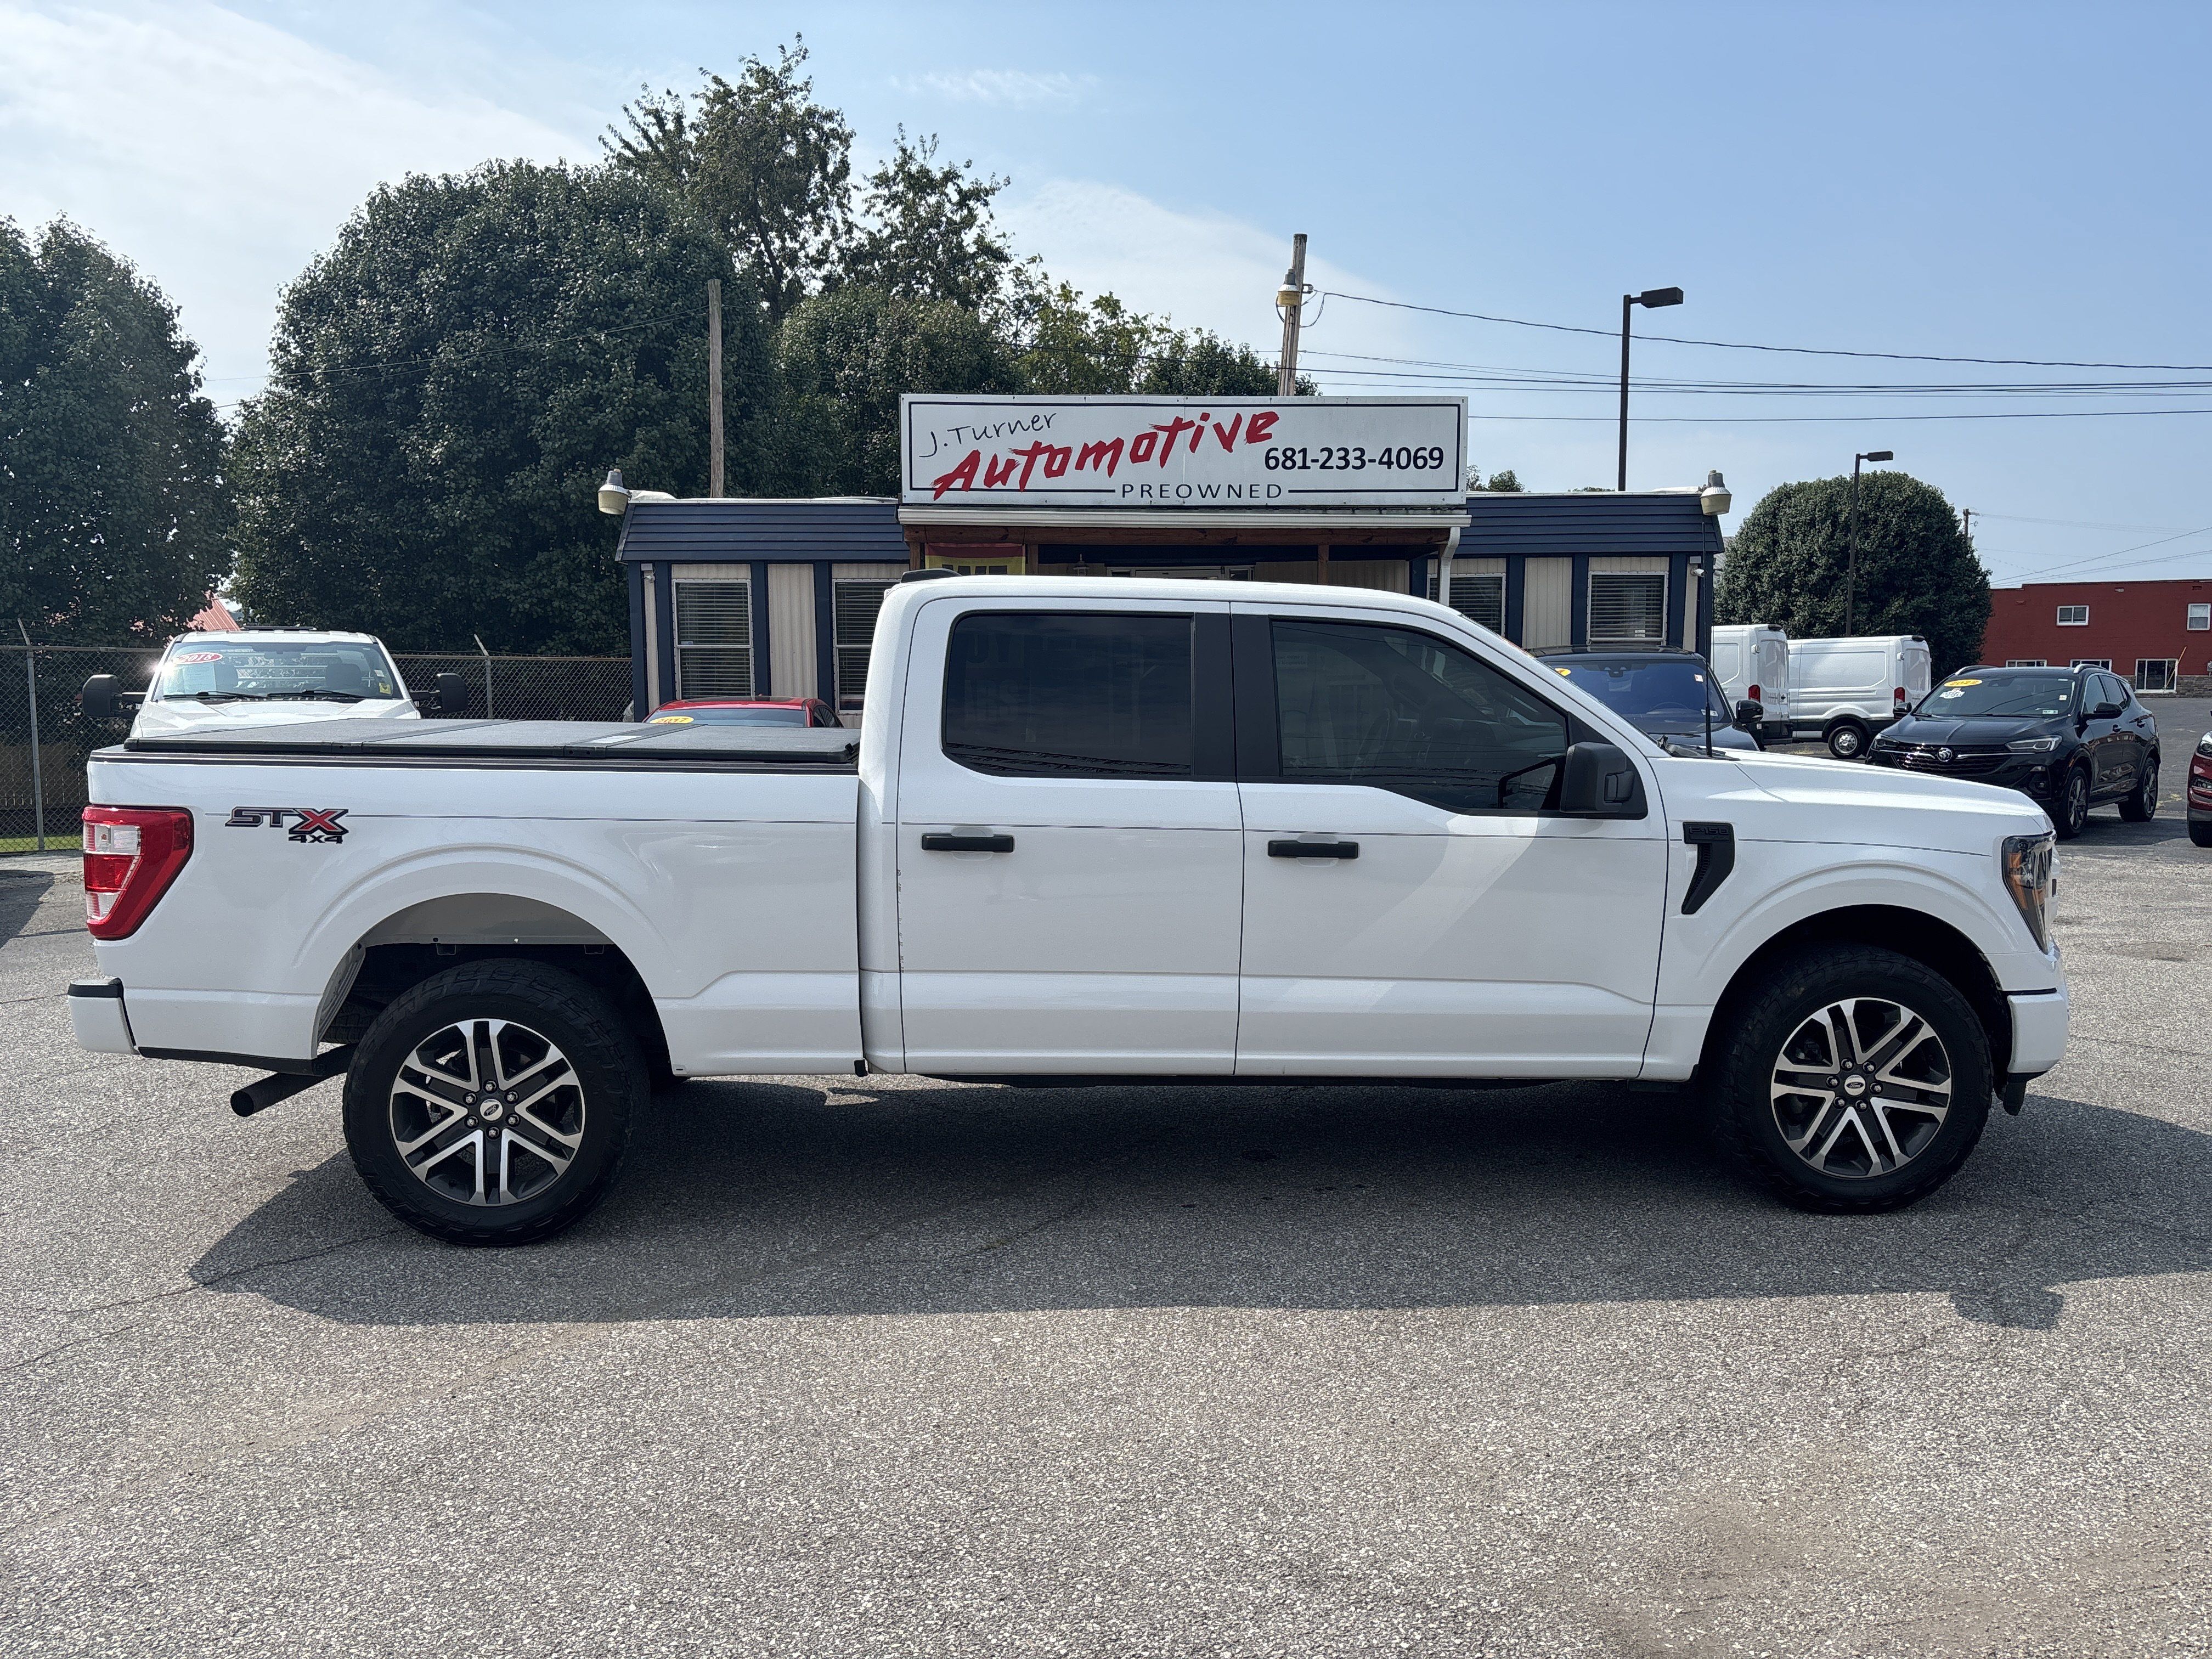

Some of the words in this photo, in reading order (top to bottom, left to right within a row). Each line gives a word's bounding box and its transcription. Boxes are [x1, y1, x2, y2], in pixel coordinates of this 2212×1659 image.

[930, 411, 1280, 500] Automotive
[1265, 447, 1444, 470] 681-233-4069
[1121, 483, 1283, 498] PREOWNED
[225, 806, 349, 835] STX
[1688, 826, 1729, 836] F-150
